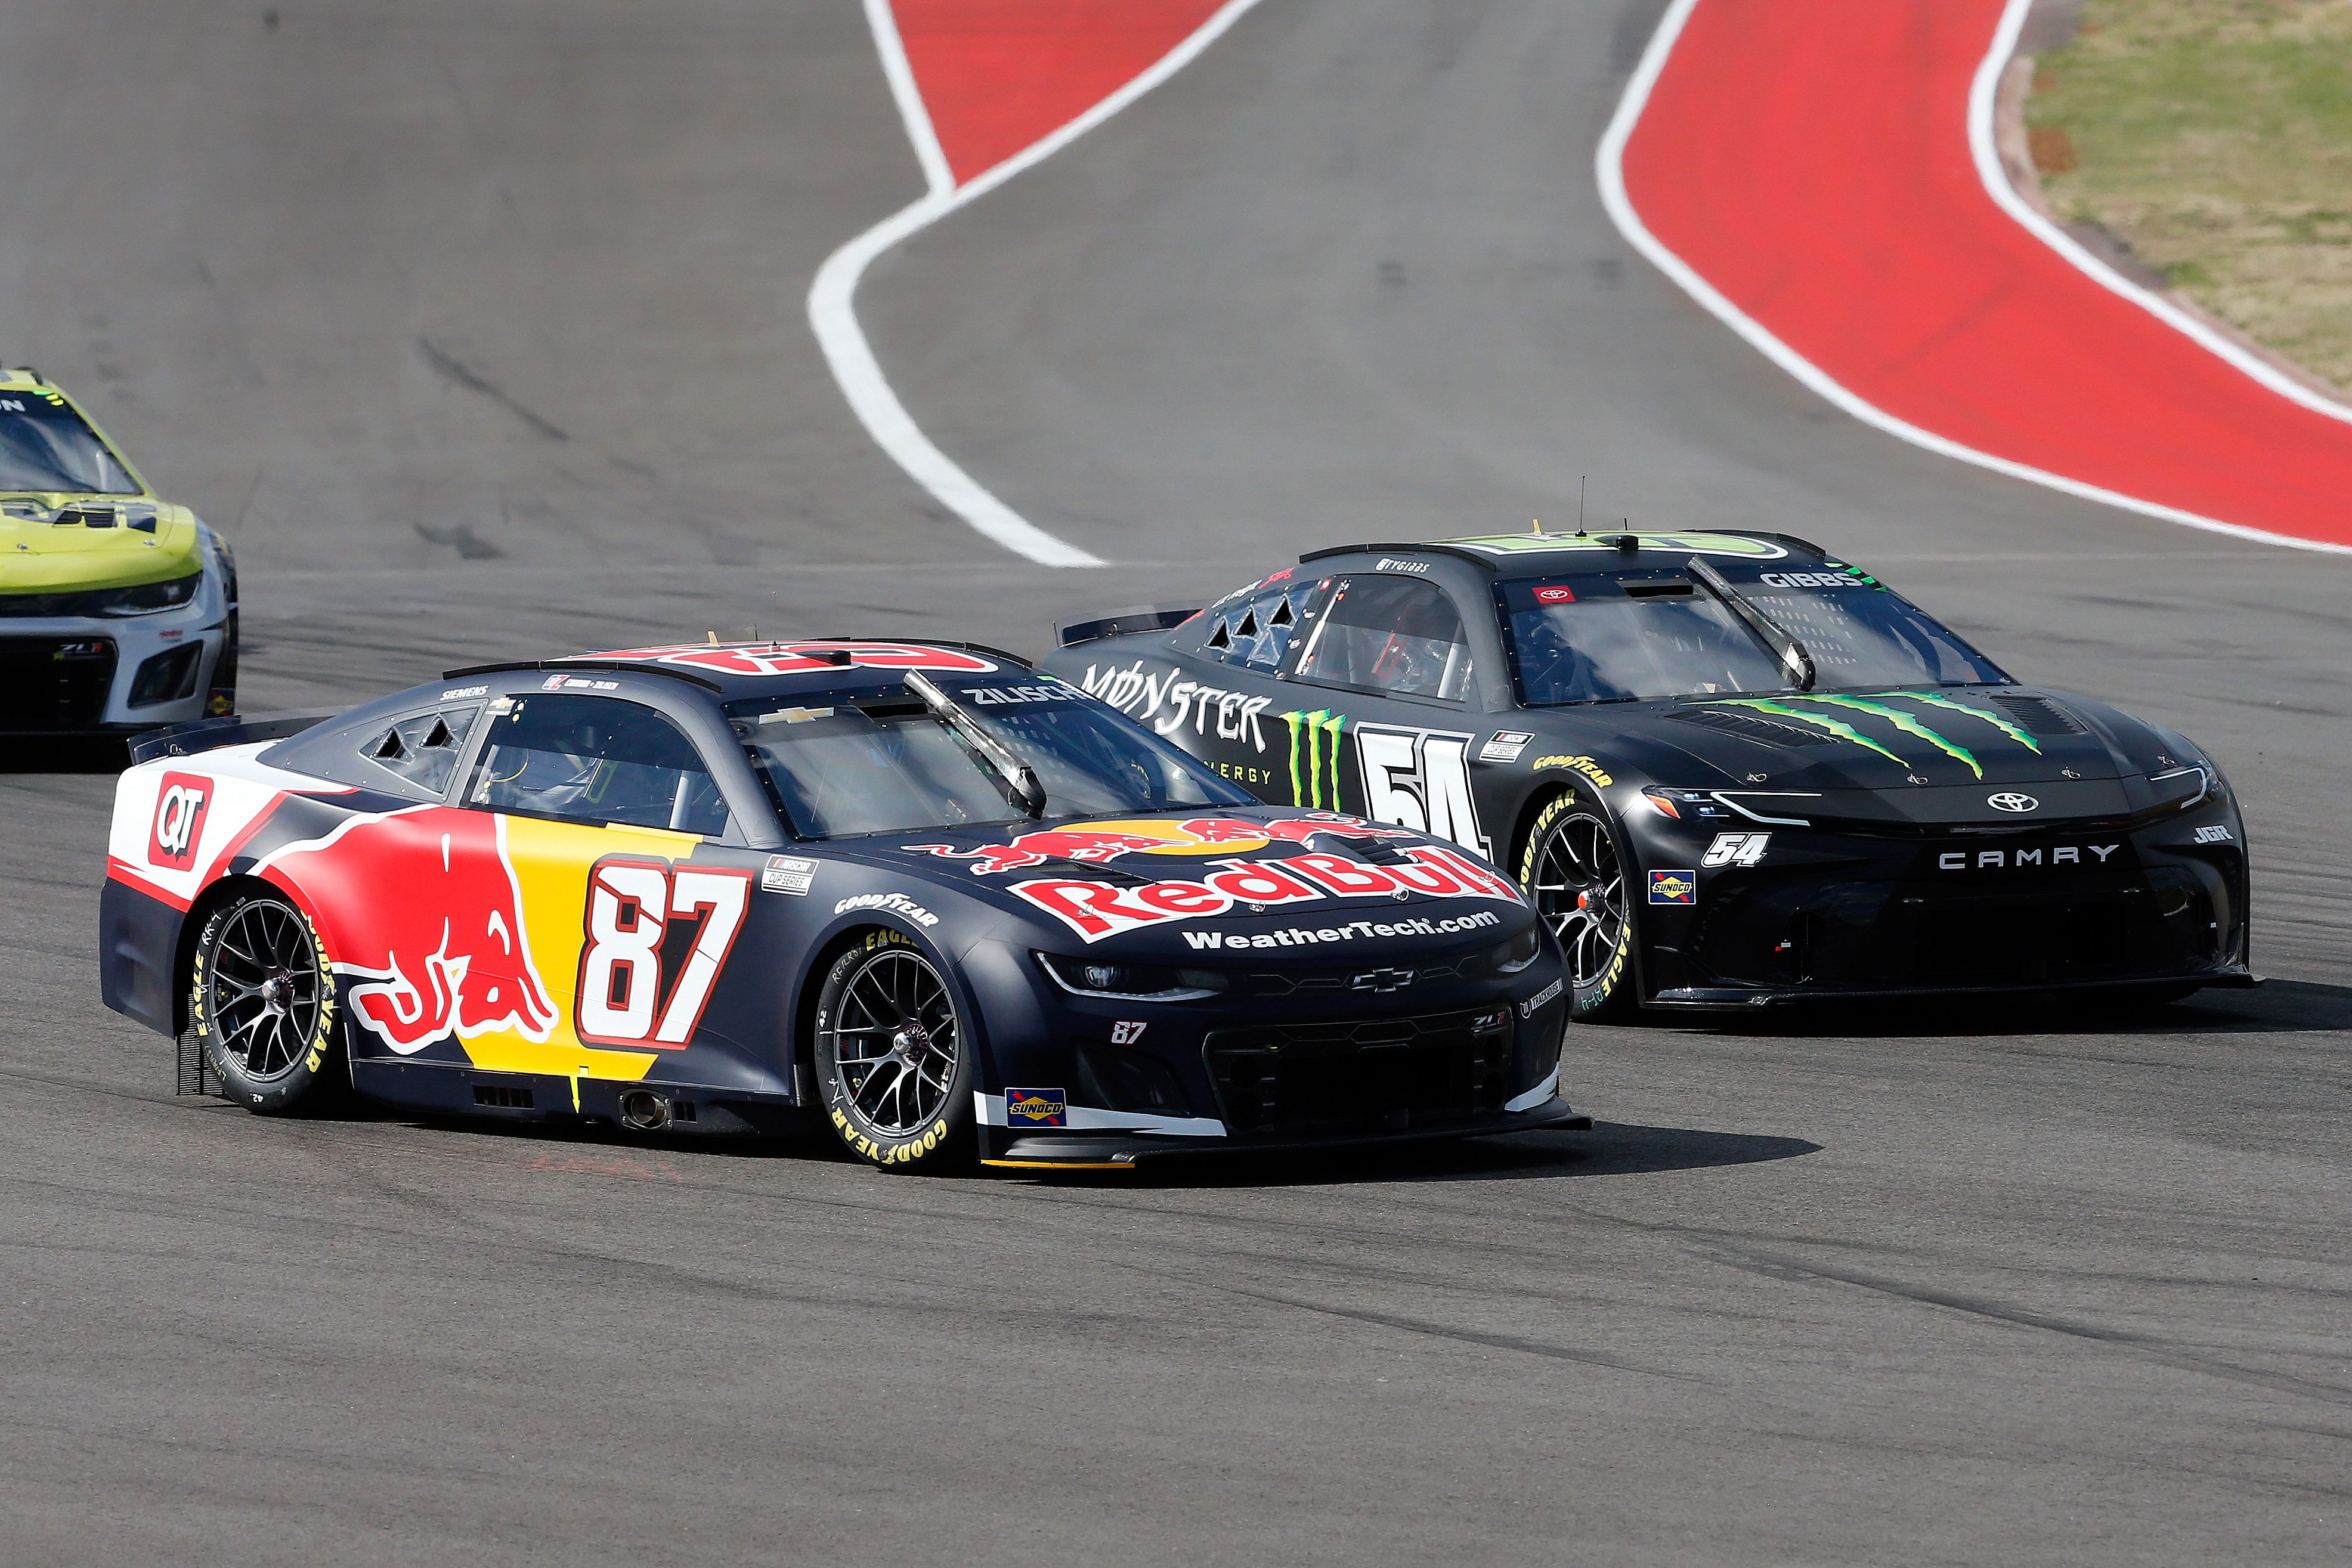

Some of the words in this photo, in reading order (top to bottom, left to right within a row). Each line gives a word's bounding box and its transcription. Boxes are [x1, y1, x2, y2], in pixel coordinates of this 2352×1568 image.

[1760, 572, 1864, 588] GIBBS
[440, 684, 489, 701] SIEMENS
[1082, 660, 1273, 754] MONSTER
[1533, 755, 1613, 788] GOODYEAR
[1354, 722, 1494, 864] 54
[157, 784, 205, 857] QT
[2194, 825, 2233, 844] JGR
[1702, 833, 1769, 867] 54
[1939, 844, 2119, 869] CAMRY
[769, 873, 782, 883] CUP
[782, 875, 804, 887] SERIES
[781, 859, 812, 872] NASCAR
[1008, 859, 1327, 943] Red
[1282, 844, 1527, 909] Bull
[1654, 882, 1692, 893] SUNOCO
[834, 893, 940, 928] GOODYEAR
[577, 862, 750, 1047] 87
[866, 928, 920, 952] EAGL
[1601, 922, 1631, 997] EAGLE
[193, 949, 208, 1036] EAGLE
[1110, 1021, 1147, 1045] 87
[1471, 1011, 1506, 1030] ZL1
[1008, 1102, 1065, 1115] SUNOCO
[831, 1107, 947, 1164] GOODYEAR
